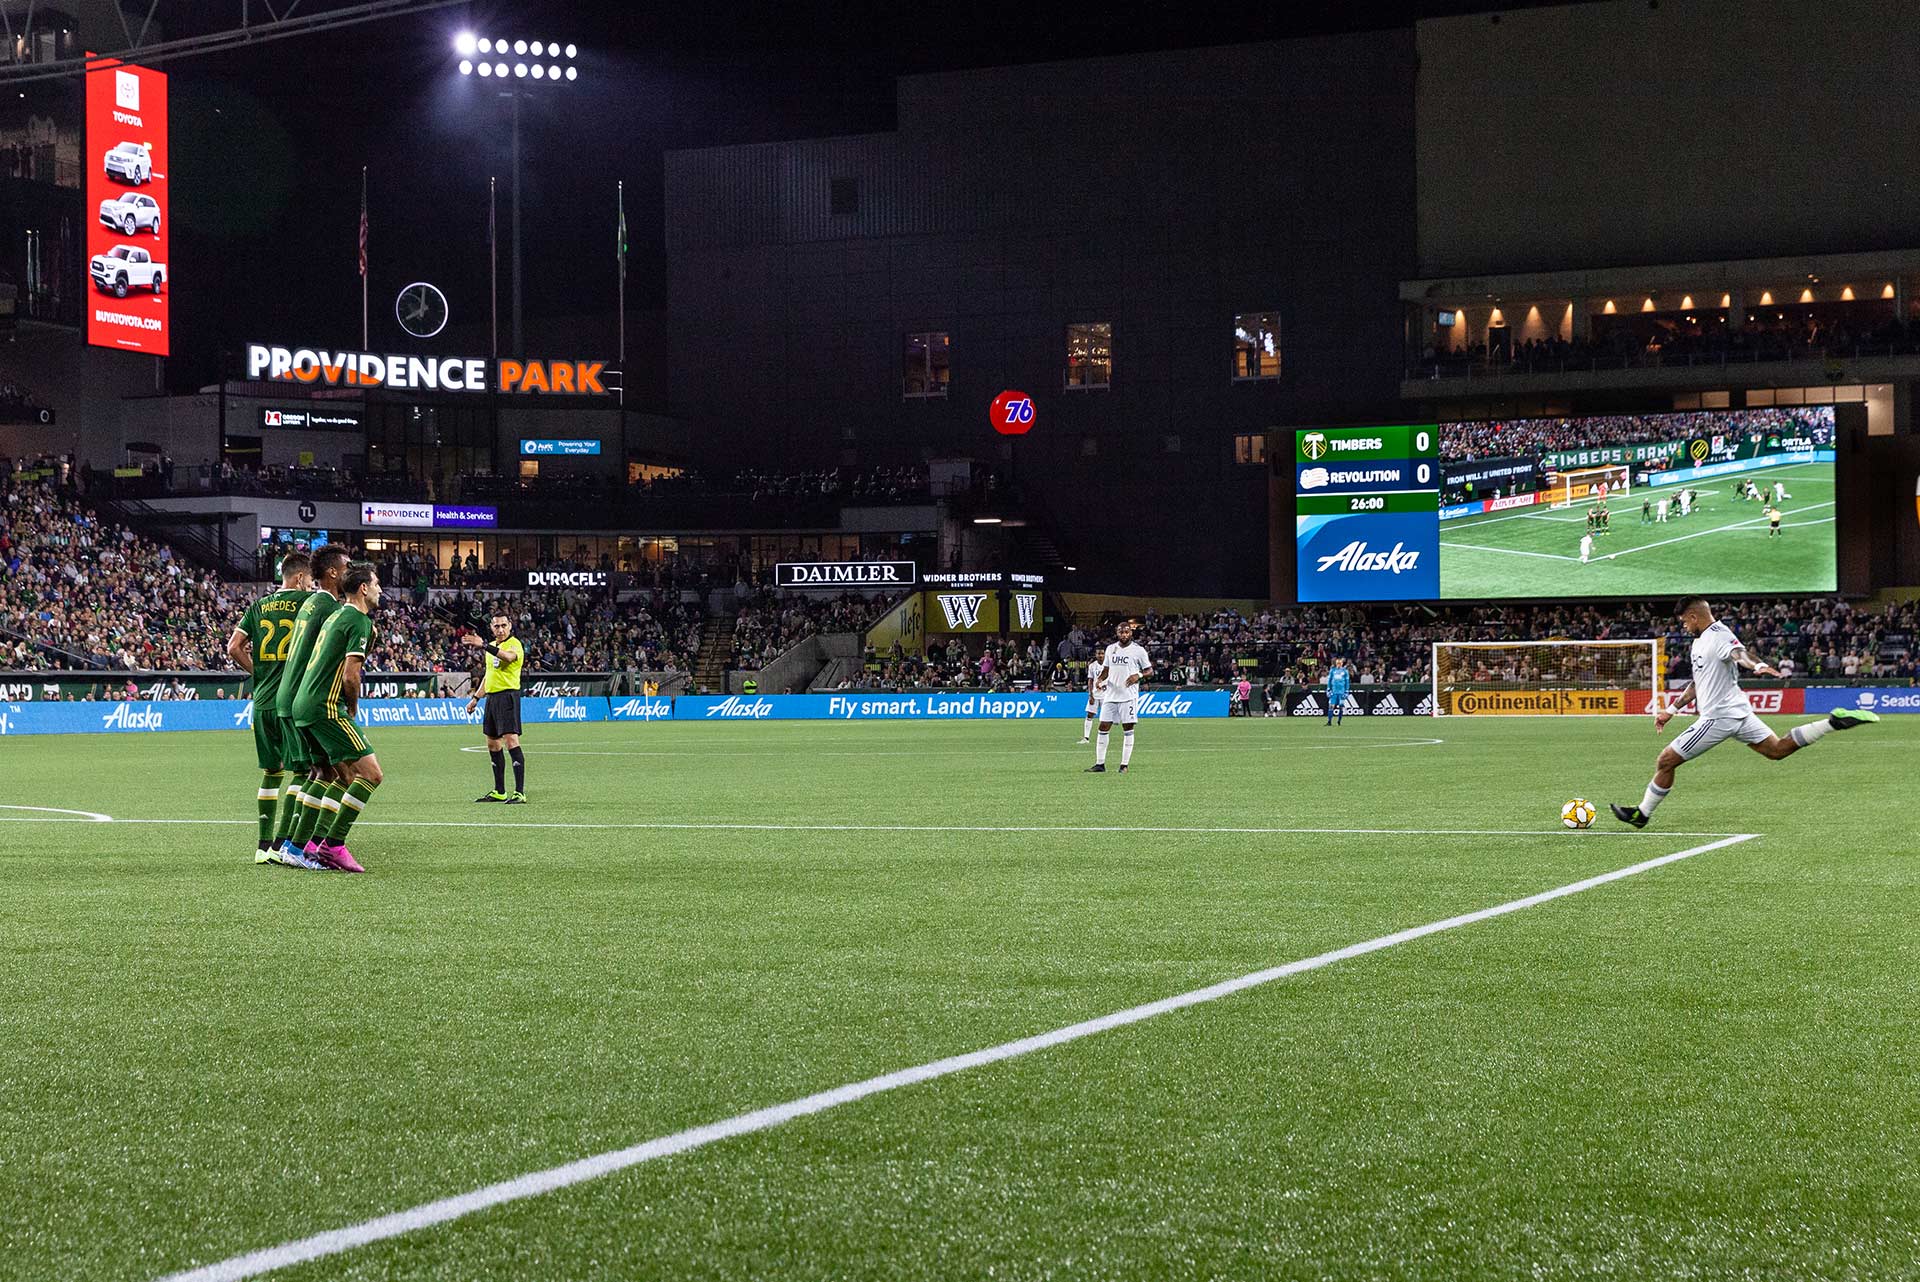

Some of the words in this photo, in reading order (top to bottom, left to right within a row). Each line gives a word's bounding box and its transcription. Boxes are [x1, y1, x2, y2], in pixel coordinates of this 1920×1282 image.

[113, 111, 143, 127] TOYOTA
[95, 310, 162, 331] BUYATOYOTA.COM
[249, 345, 486, 390] PROVIDENCE
[500, 360, 604, 392] PARK
[1005, 398, 1034, 423] 76
[1330, 438, 1383, 451] TIMBERS
[1416, 432, 1430, 451] 0
[1548, 450, 1622, 466] TIMBERS
[1637, 443, 1677, 460] ARMY
[1330, 470, 1400, 483] REVOLUTION
[1417, 464, 1431, 483] 0
[1447, 476, 1465, 485] IRON
[1466, 473, 1482, 482] WILL
[300, 506, 314, 517] TL
[1351, 497, 1384, 510] 26:00
[377, 509, 430, 518] PROVIDENCE
[436, 511, 458, 519] Health
[459, 511, 465, 520] &
[466, 511, 494, 520] Services
[1316, 541, 1420, 574] Alaska
[791, 565, 900, 582] DAIMLER
[923, 574, 957, 582] WIDMER
[958, 573, 1002, 581] BROTHERS
[261, 601, 297, 614] PAREDES
[936, 594, 988, 629] W
[259, 618, 295, 662] 22
[1111, 656, 1129, 664] UHC
[373, 704, 415, 721] smart.
[415, 702, 447, 721] Land
[547, 697, 586, 720] Alaska
[613, 699, 669, 718] Alaska
[705, 696, 773, 718] Alaska
[829, 697, 858, 718] Fly
[861, 698, 921, 715] smart.
[927, 696, 974, 715] Land
[1293, 707, 1324, 716] adidas
[1372, 707, 1404, 716] adidas
[1457, 692, 1558, 714] Continental
[1578, 697, 1619, 709] TIRE
[102, 702, 163, 731] Alaska
